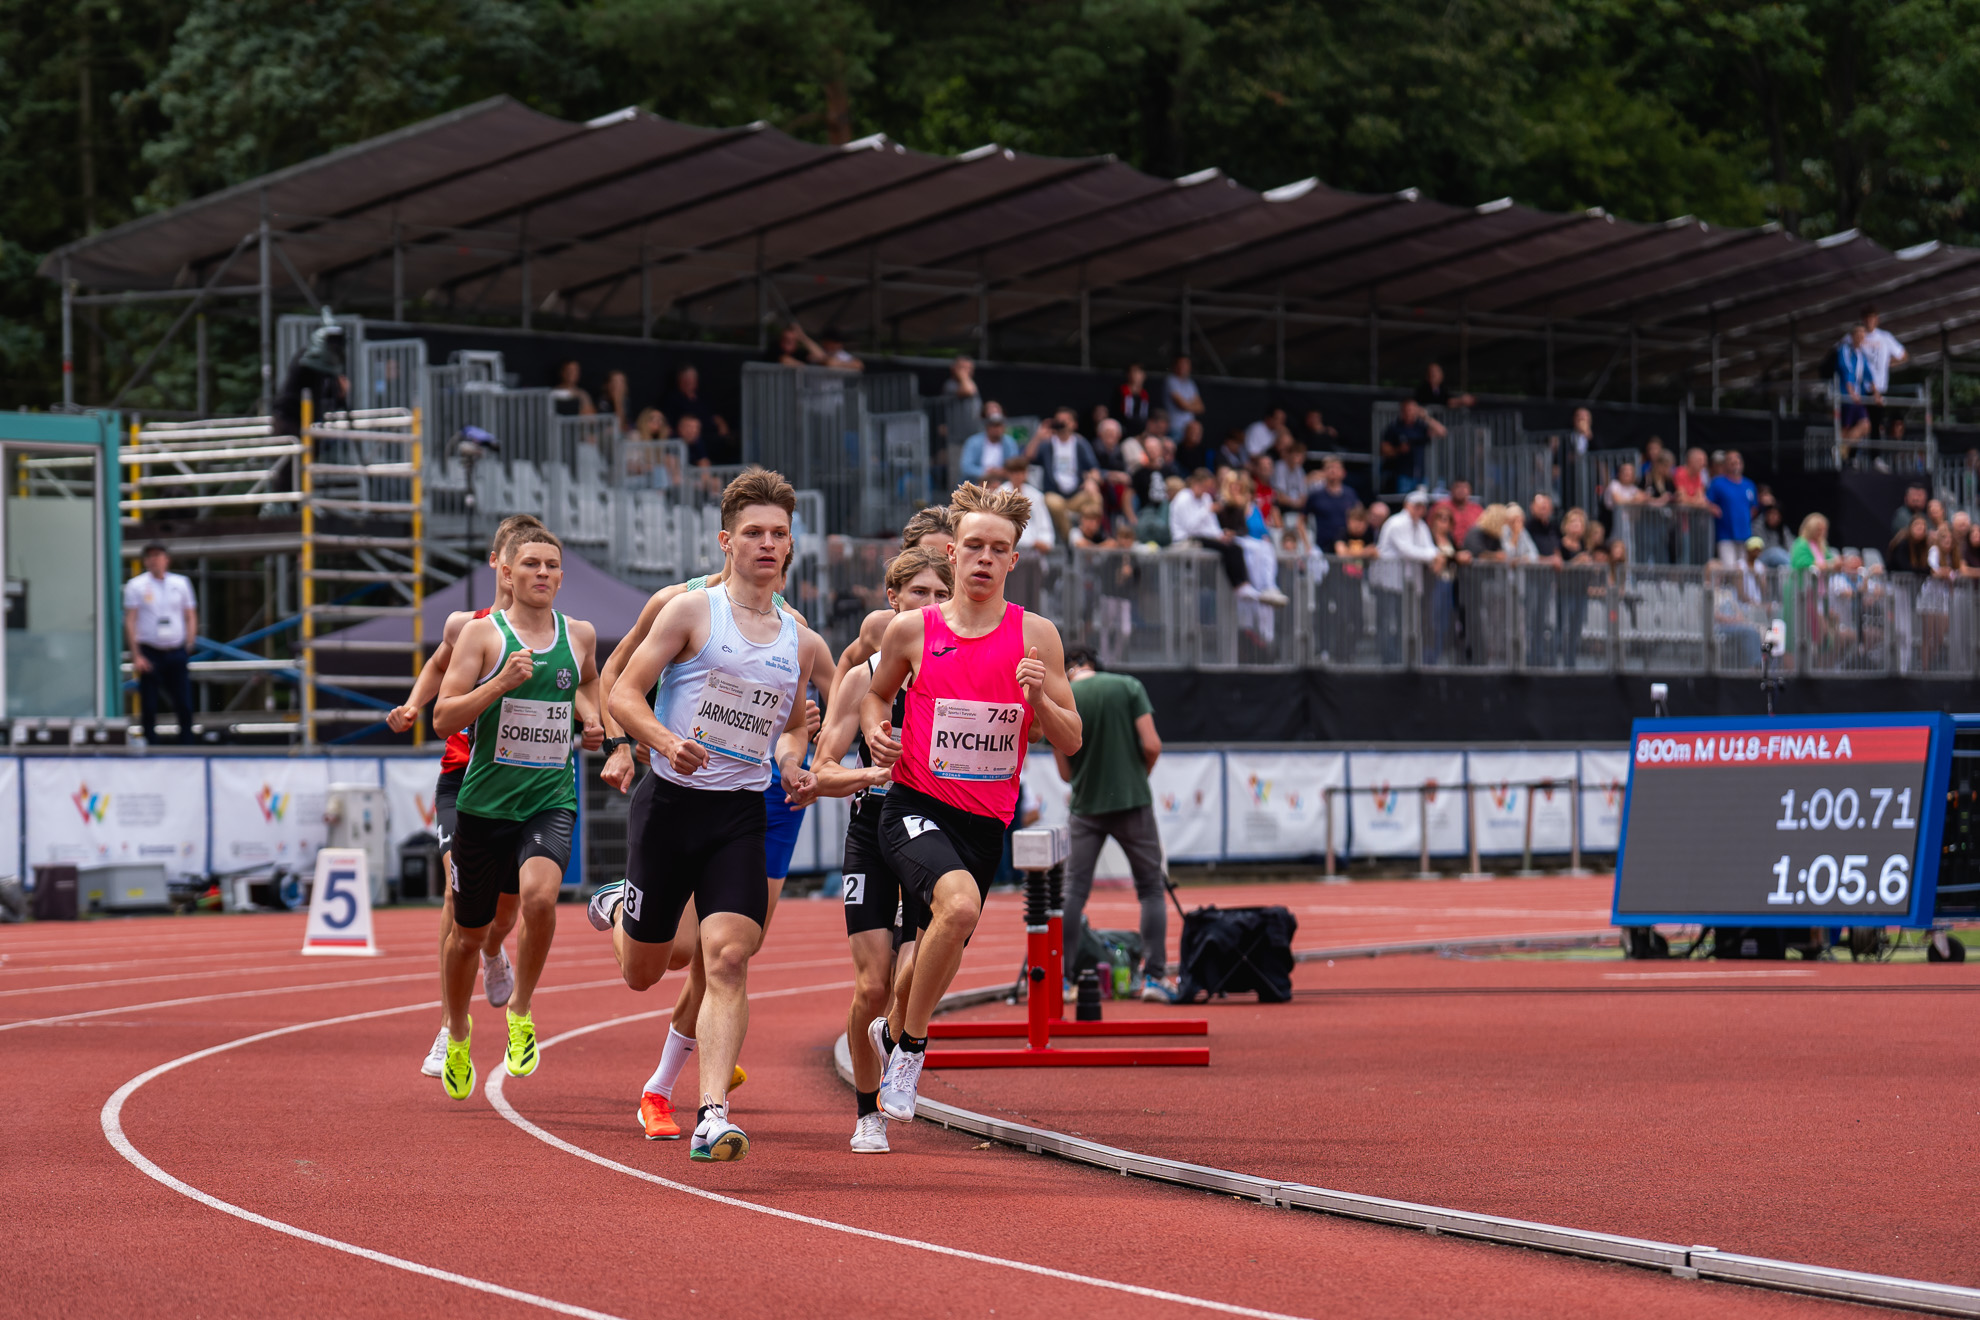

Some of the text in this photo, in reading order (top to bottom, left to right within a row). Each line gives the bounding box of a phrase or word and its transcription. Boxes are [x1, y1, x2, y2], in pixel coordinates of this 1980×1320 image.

[752, 690, 779, 709] 179
[547, 707, 568, 720] 156
[698, 700, 773, 737] JARMOSZEWICZ
[988, 708, 1018, 723] 743
[501, 724, 569, 744] SOBIESIAK
[936, 731, 1015, 752] RYCHLIK
[1636, 734, 1852, 763] 800m M U18-FINAŁ A
[1776, 787, 1915, 831] 1:00.71
[910, 816, 928, 832] 7
[845, 876, 858, 902] 2
[1767, 853, 1910, 906] 1:05.6
[321, 869, 358, 930] 5
[626, 886, 637, 914] 8
